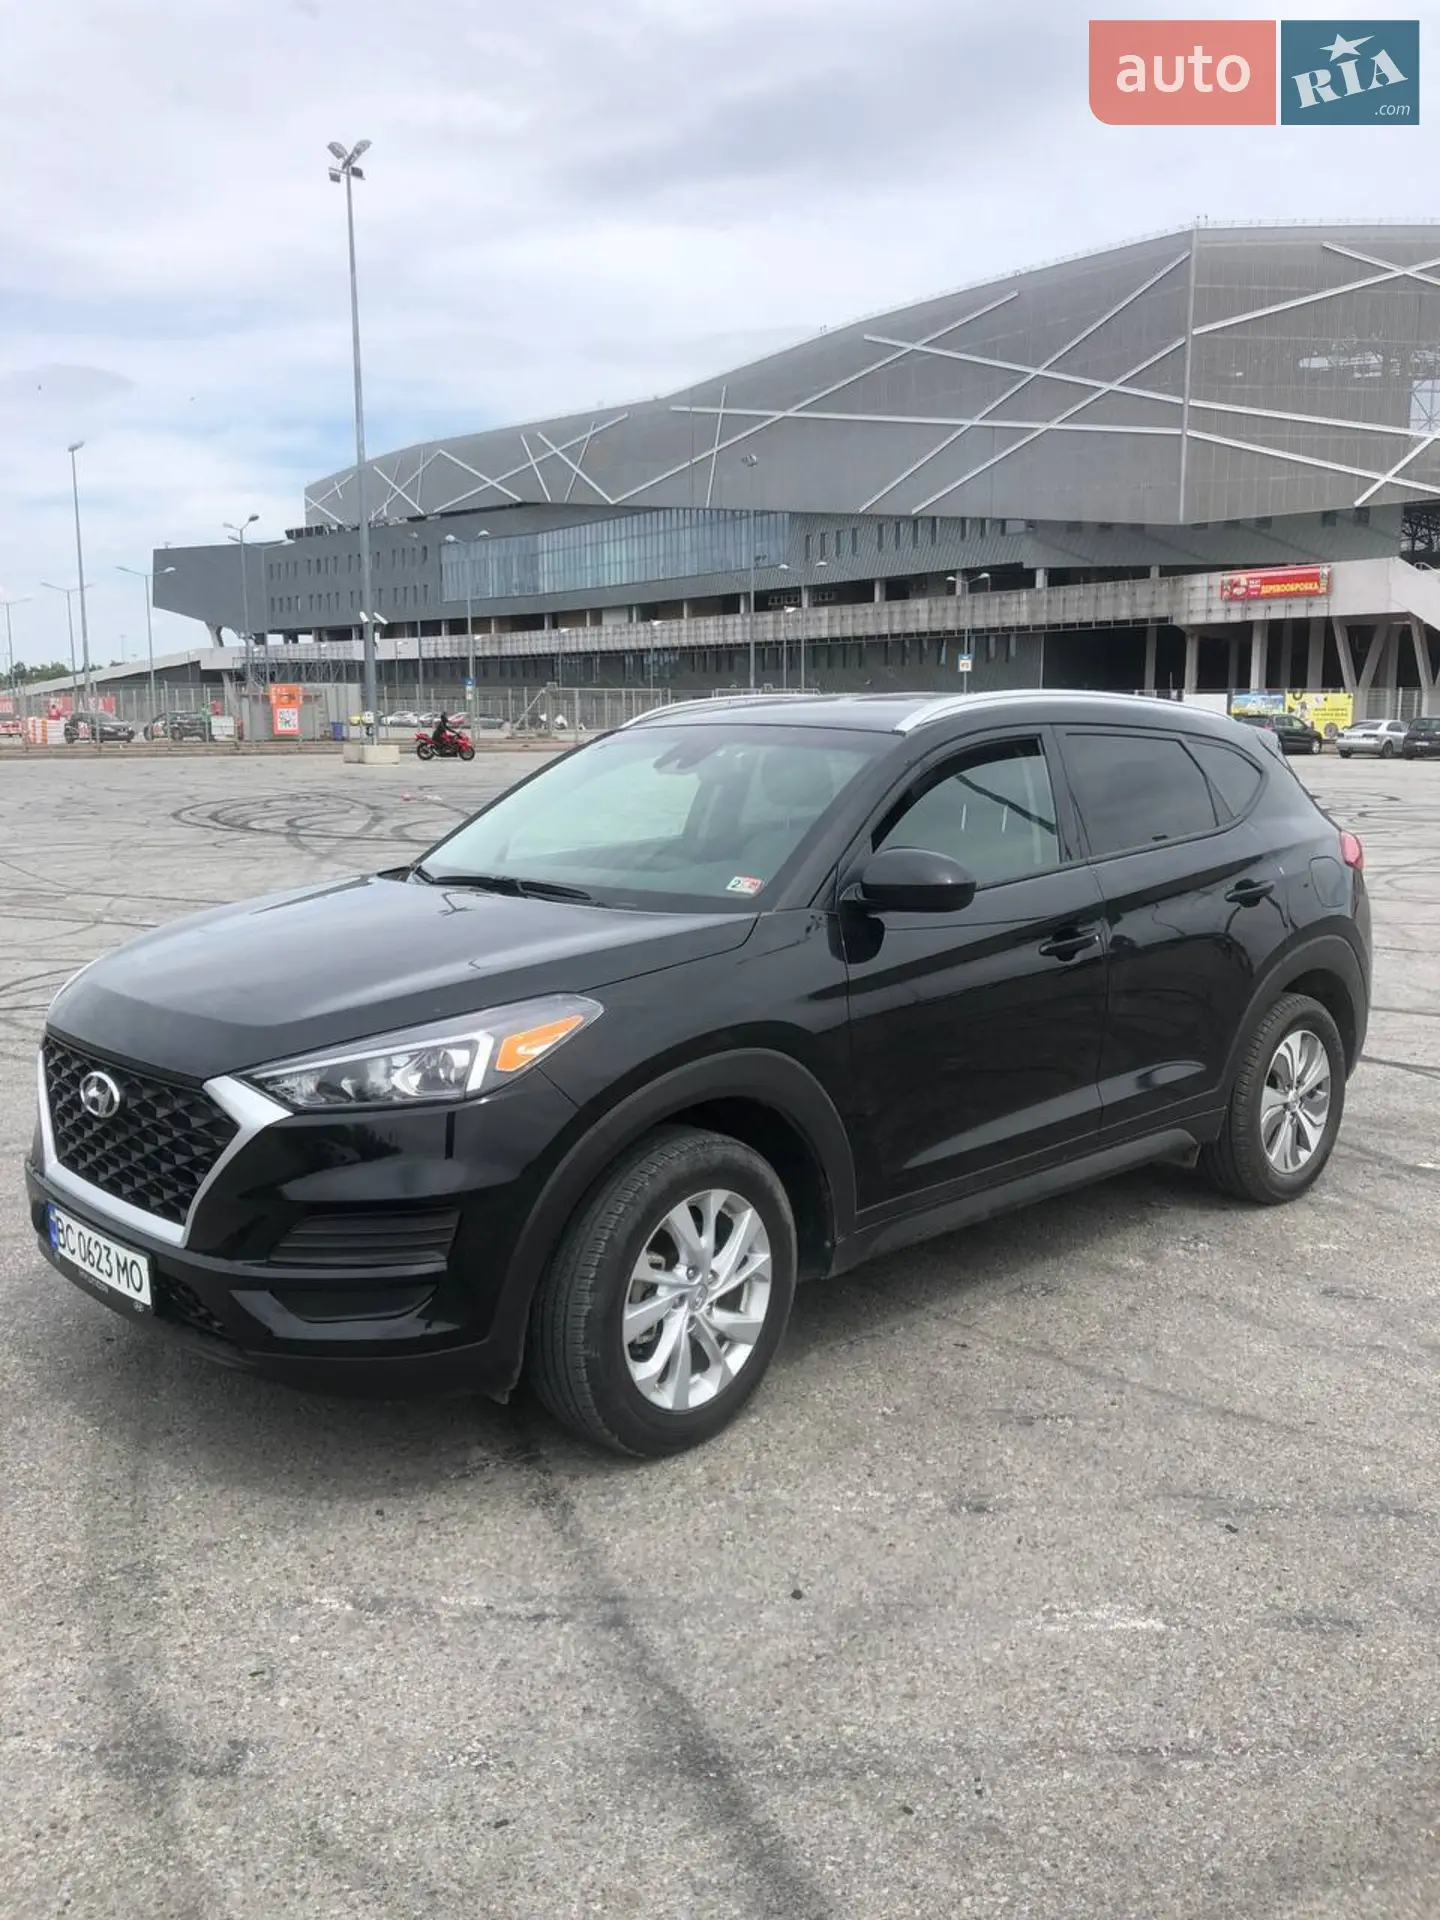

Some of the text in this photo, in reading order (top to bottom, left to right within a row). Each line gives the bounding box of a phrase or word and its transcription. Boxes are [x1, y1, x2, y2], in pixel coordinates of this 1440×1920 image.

[56, 1216, 76, 1256] BC
[77, 1230, 113, 1278] 0623
[115, 1252, 143, 1293] MO
